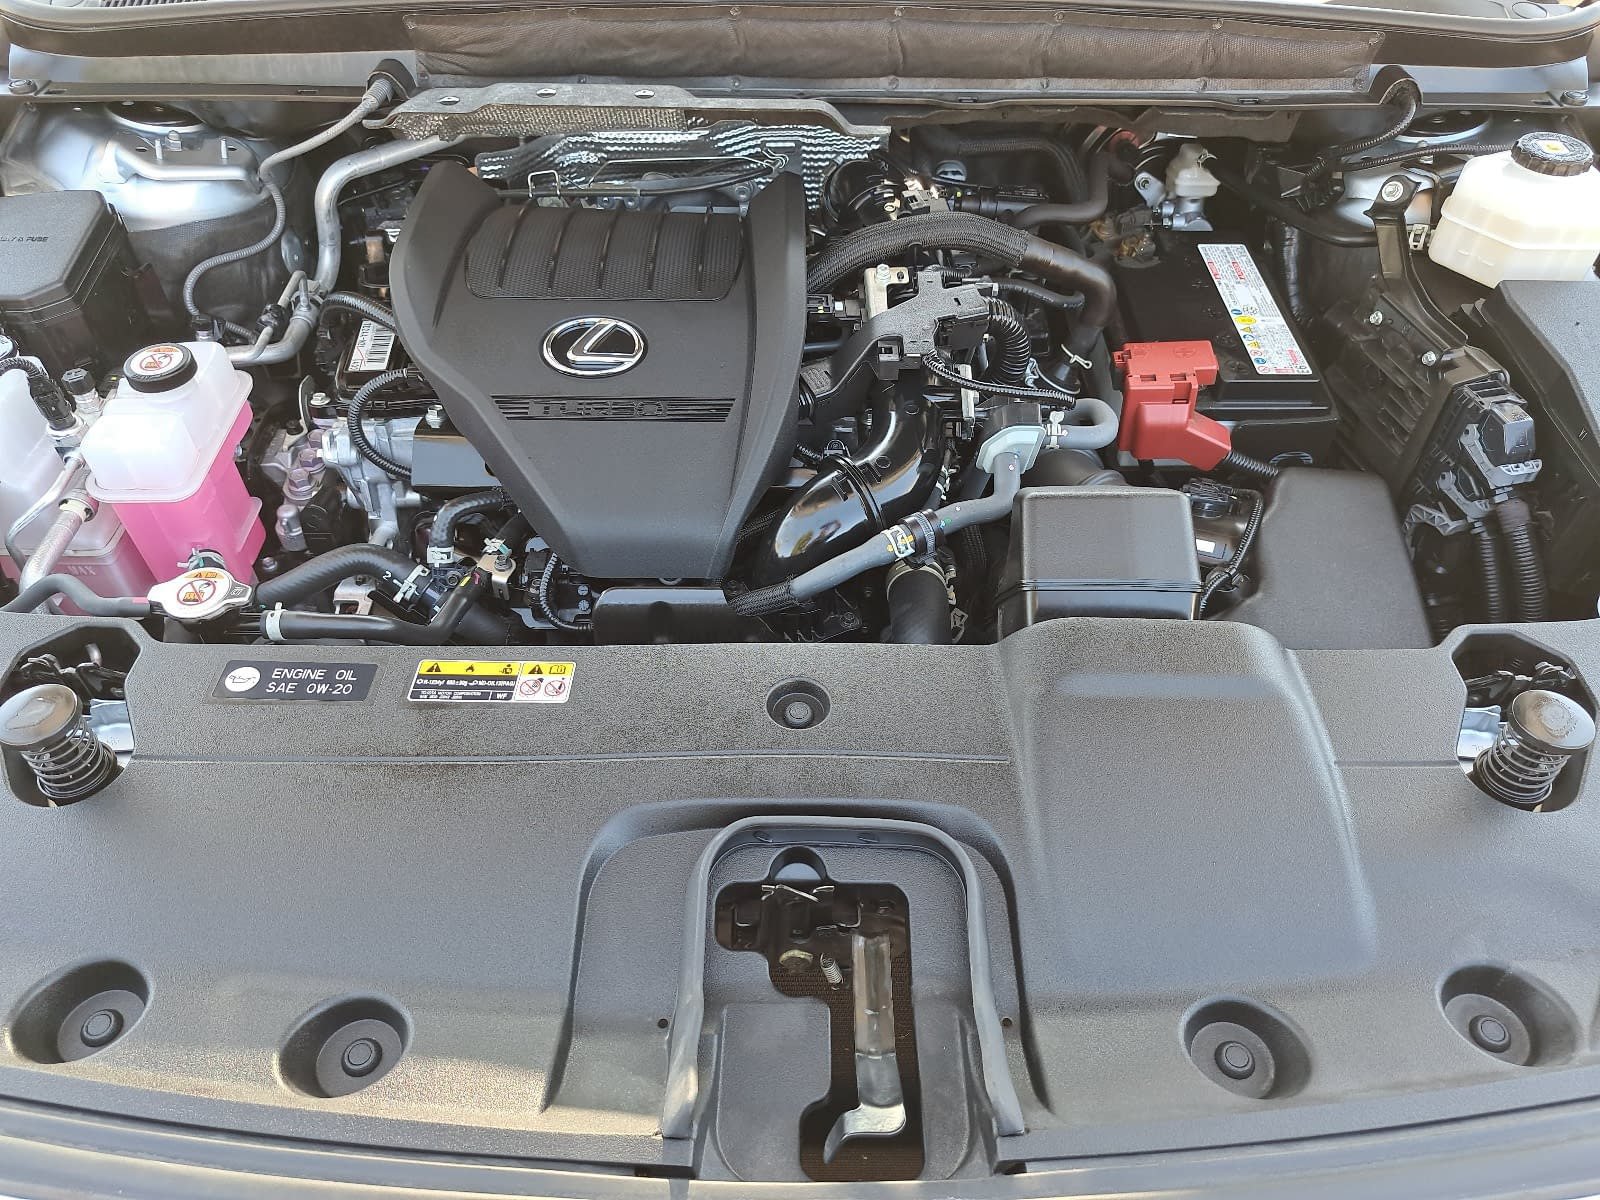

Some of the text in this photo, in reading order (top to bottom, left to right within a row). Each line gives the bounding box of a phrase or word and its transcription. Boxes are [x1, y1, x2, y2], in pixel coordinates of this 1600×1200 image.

[528, 400, 668, 418] TURBO
[271, 667, 358, 681] ENGINE OIL
[265, 681, 353, 695] SAE 0W-20
